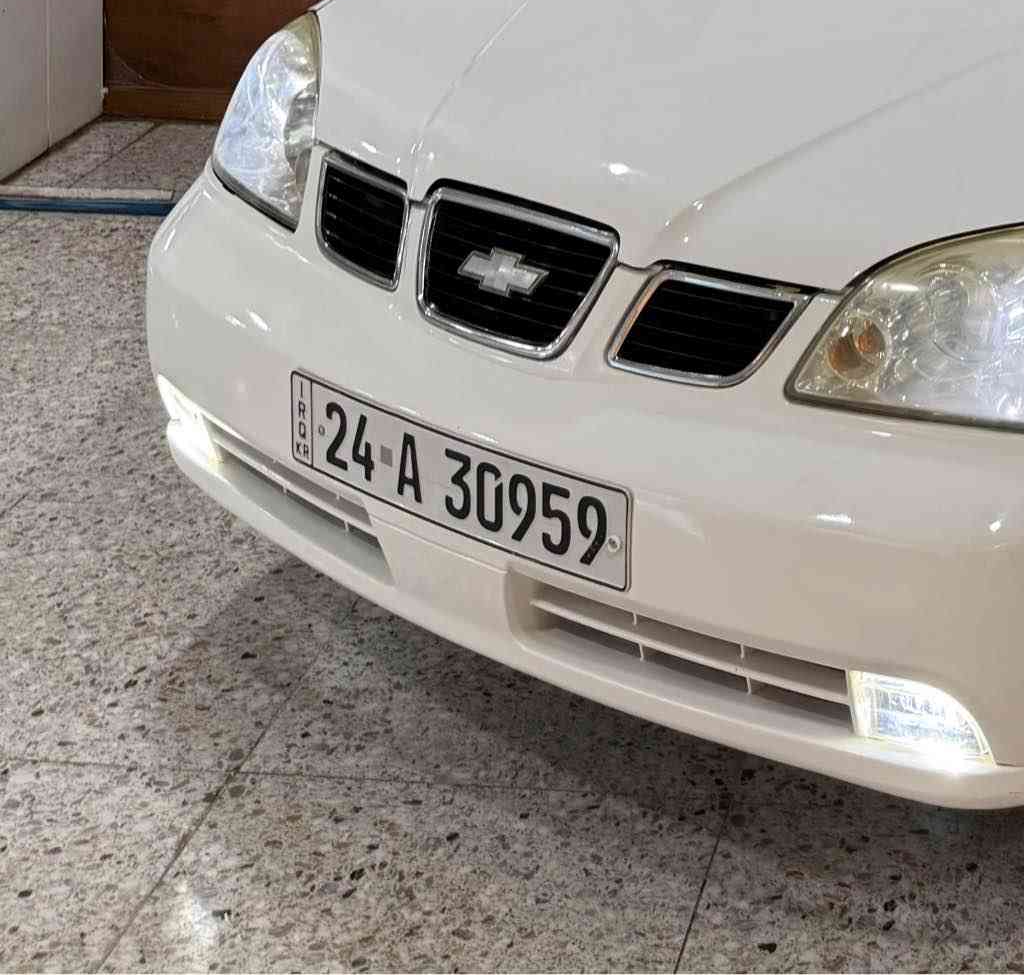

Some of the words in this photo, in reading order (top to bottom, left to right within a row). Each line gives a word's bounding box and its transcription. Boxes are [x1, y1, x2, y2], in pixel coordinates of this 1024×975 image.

[325, 401, 374, 482] 24
[397, 432, 423, 504] A
[444, 447, 608, 566] 30959
